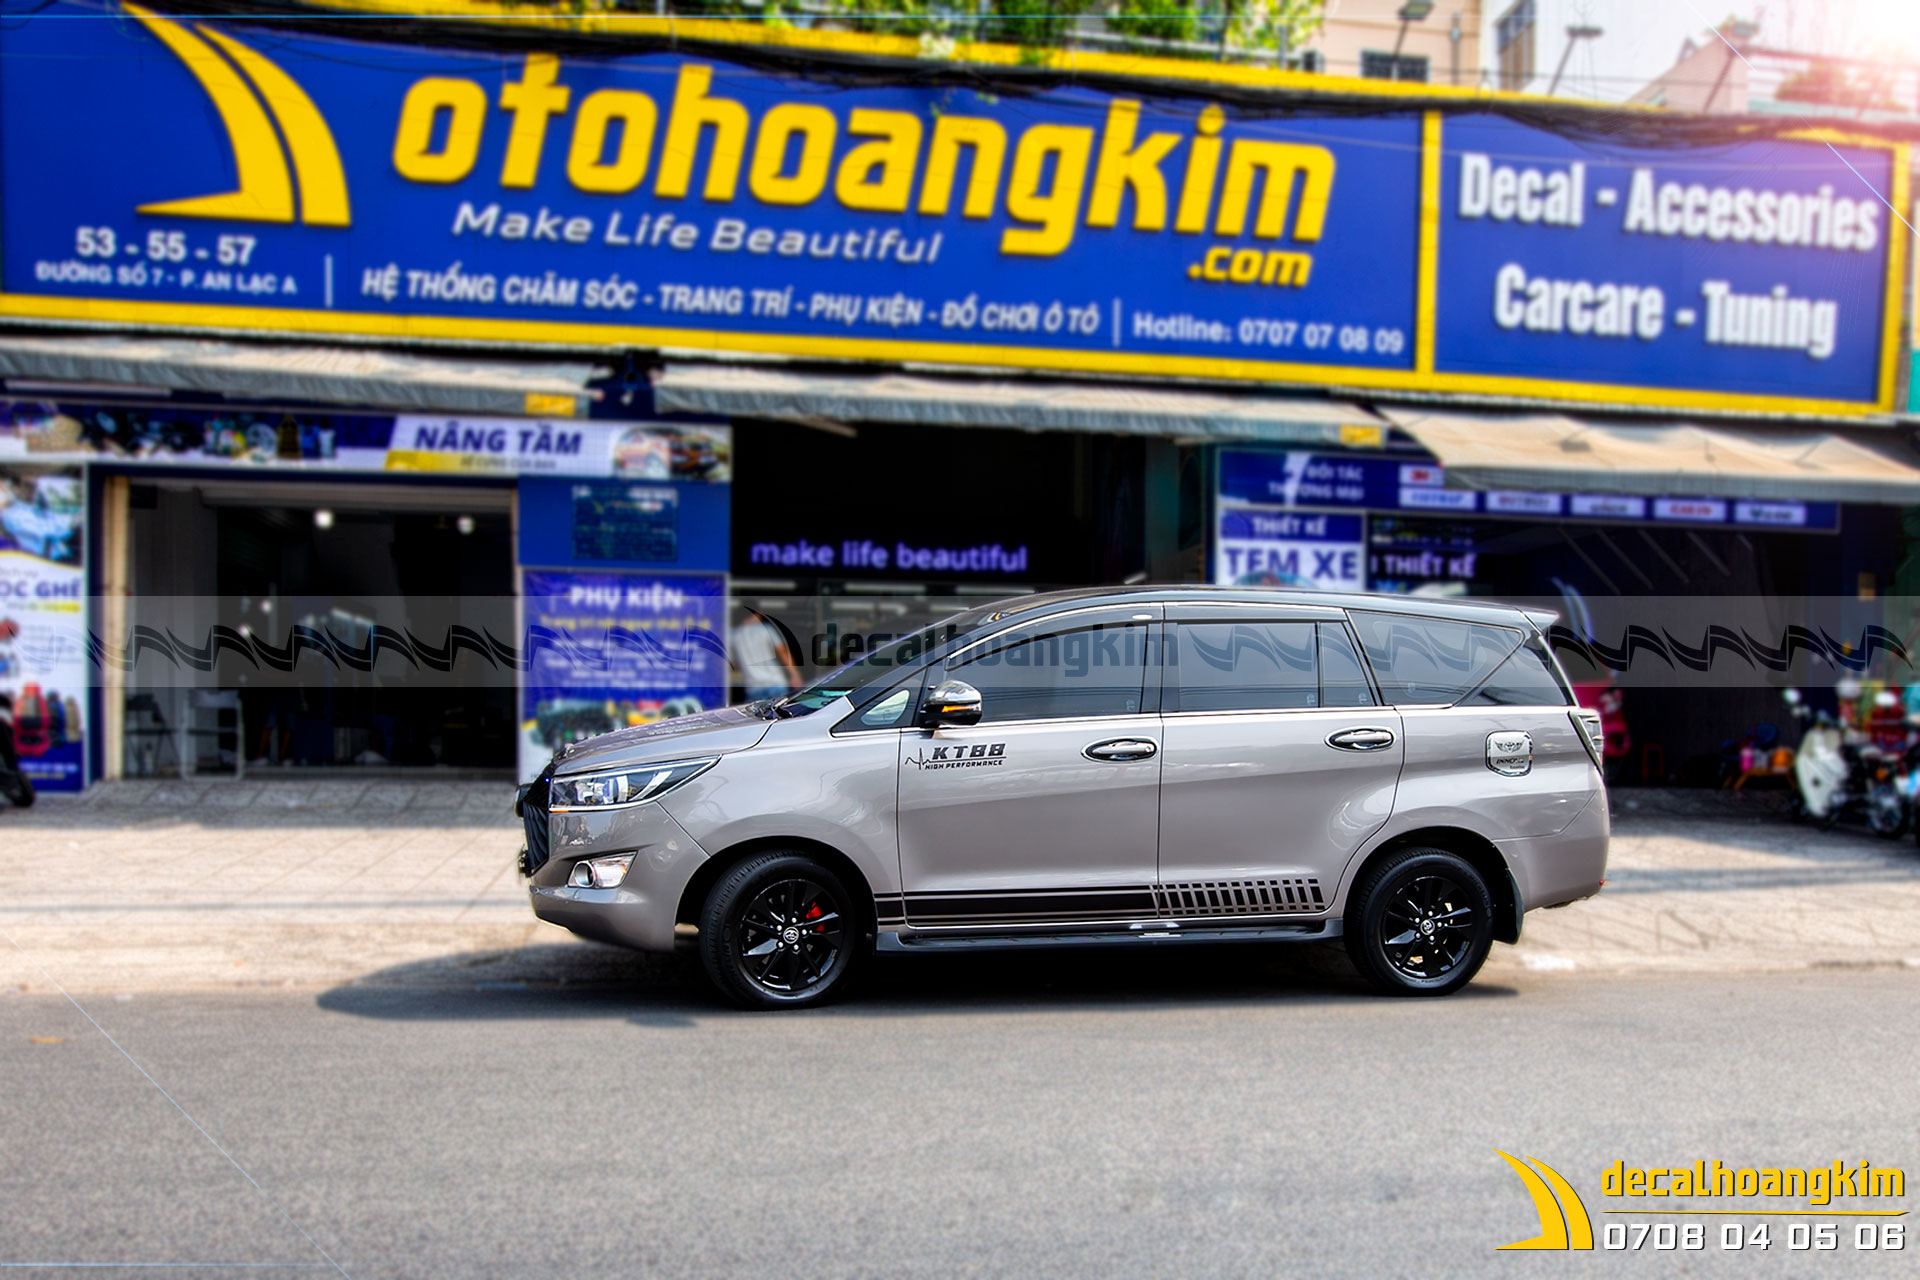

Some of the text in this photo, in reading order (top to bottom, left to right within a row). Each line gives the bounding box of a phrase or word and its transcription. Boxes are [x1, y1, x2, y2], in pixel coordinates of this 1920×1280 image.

[393, 53, 1336, 256] otohoangkim
[1459, 152, 1584, 228] Decal
[1624, 167, 1880, 252] Accessories
[75, 226, 116, 257] 53
[147, 231, 187, 262] 55
[216, 235, 256, 265] 57
[452, 202, 942, 264] Make Life Beautiful
[117, 261, 147, 286] SỐ
[152, 268, 163, 286] 7
[236, 274, 277, 294] LẠC
[282, 275, 297, 294] A
[1187, 246, 1313, 287] .com
[361, 263, 398, 301] HỆ
[407, 261, 495, 302] THỐNG
[503, 271, 577, 305] CHĂM
[583, 273, 637, 308] SÓC
[659, 284, 743, 316] TRANG
[751, 285, 793, 316] TRÍ
[809, 293, 860, 326] PHỤ
[866, 291, 924, 327] KIỆN
[981, 301, 1039, 332] CHƠI
[1494, 263, 1664, 339] Carcare
[1703, 281, 1839, 360] Tuning
[1133, 312, 1403, 354] Hotline: 0707 07 08 09
[414, 420, 506, 452] NÂNG
[1338, 464, 1364, 481] TÁC
[1268, 481, 1331, 498] THƠNG
[1253, 513, 1327, 536] THIẾT KẾ
[751, 539, 1027, 572] make life beautiful
[1311, 550, 1357, 581] XE
[1383, 551, 1444, 576] THIẾT
[1449, 551, 1477, 578] KẾ
[35, 576, 82, 598] GHẾ
[570, 583, 684, 612] PHỤ KIỆN
[946, 760, 1003, 769] PERFORMANCE
